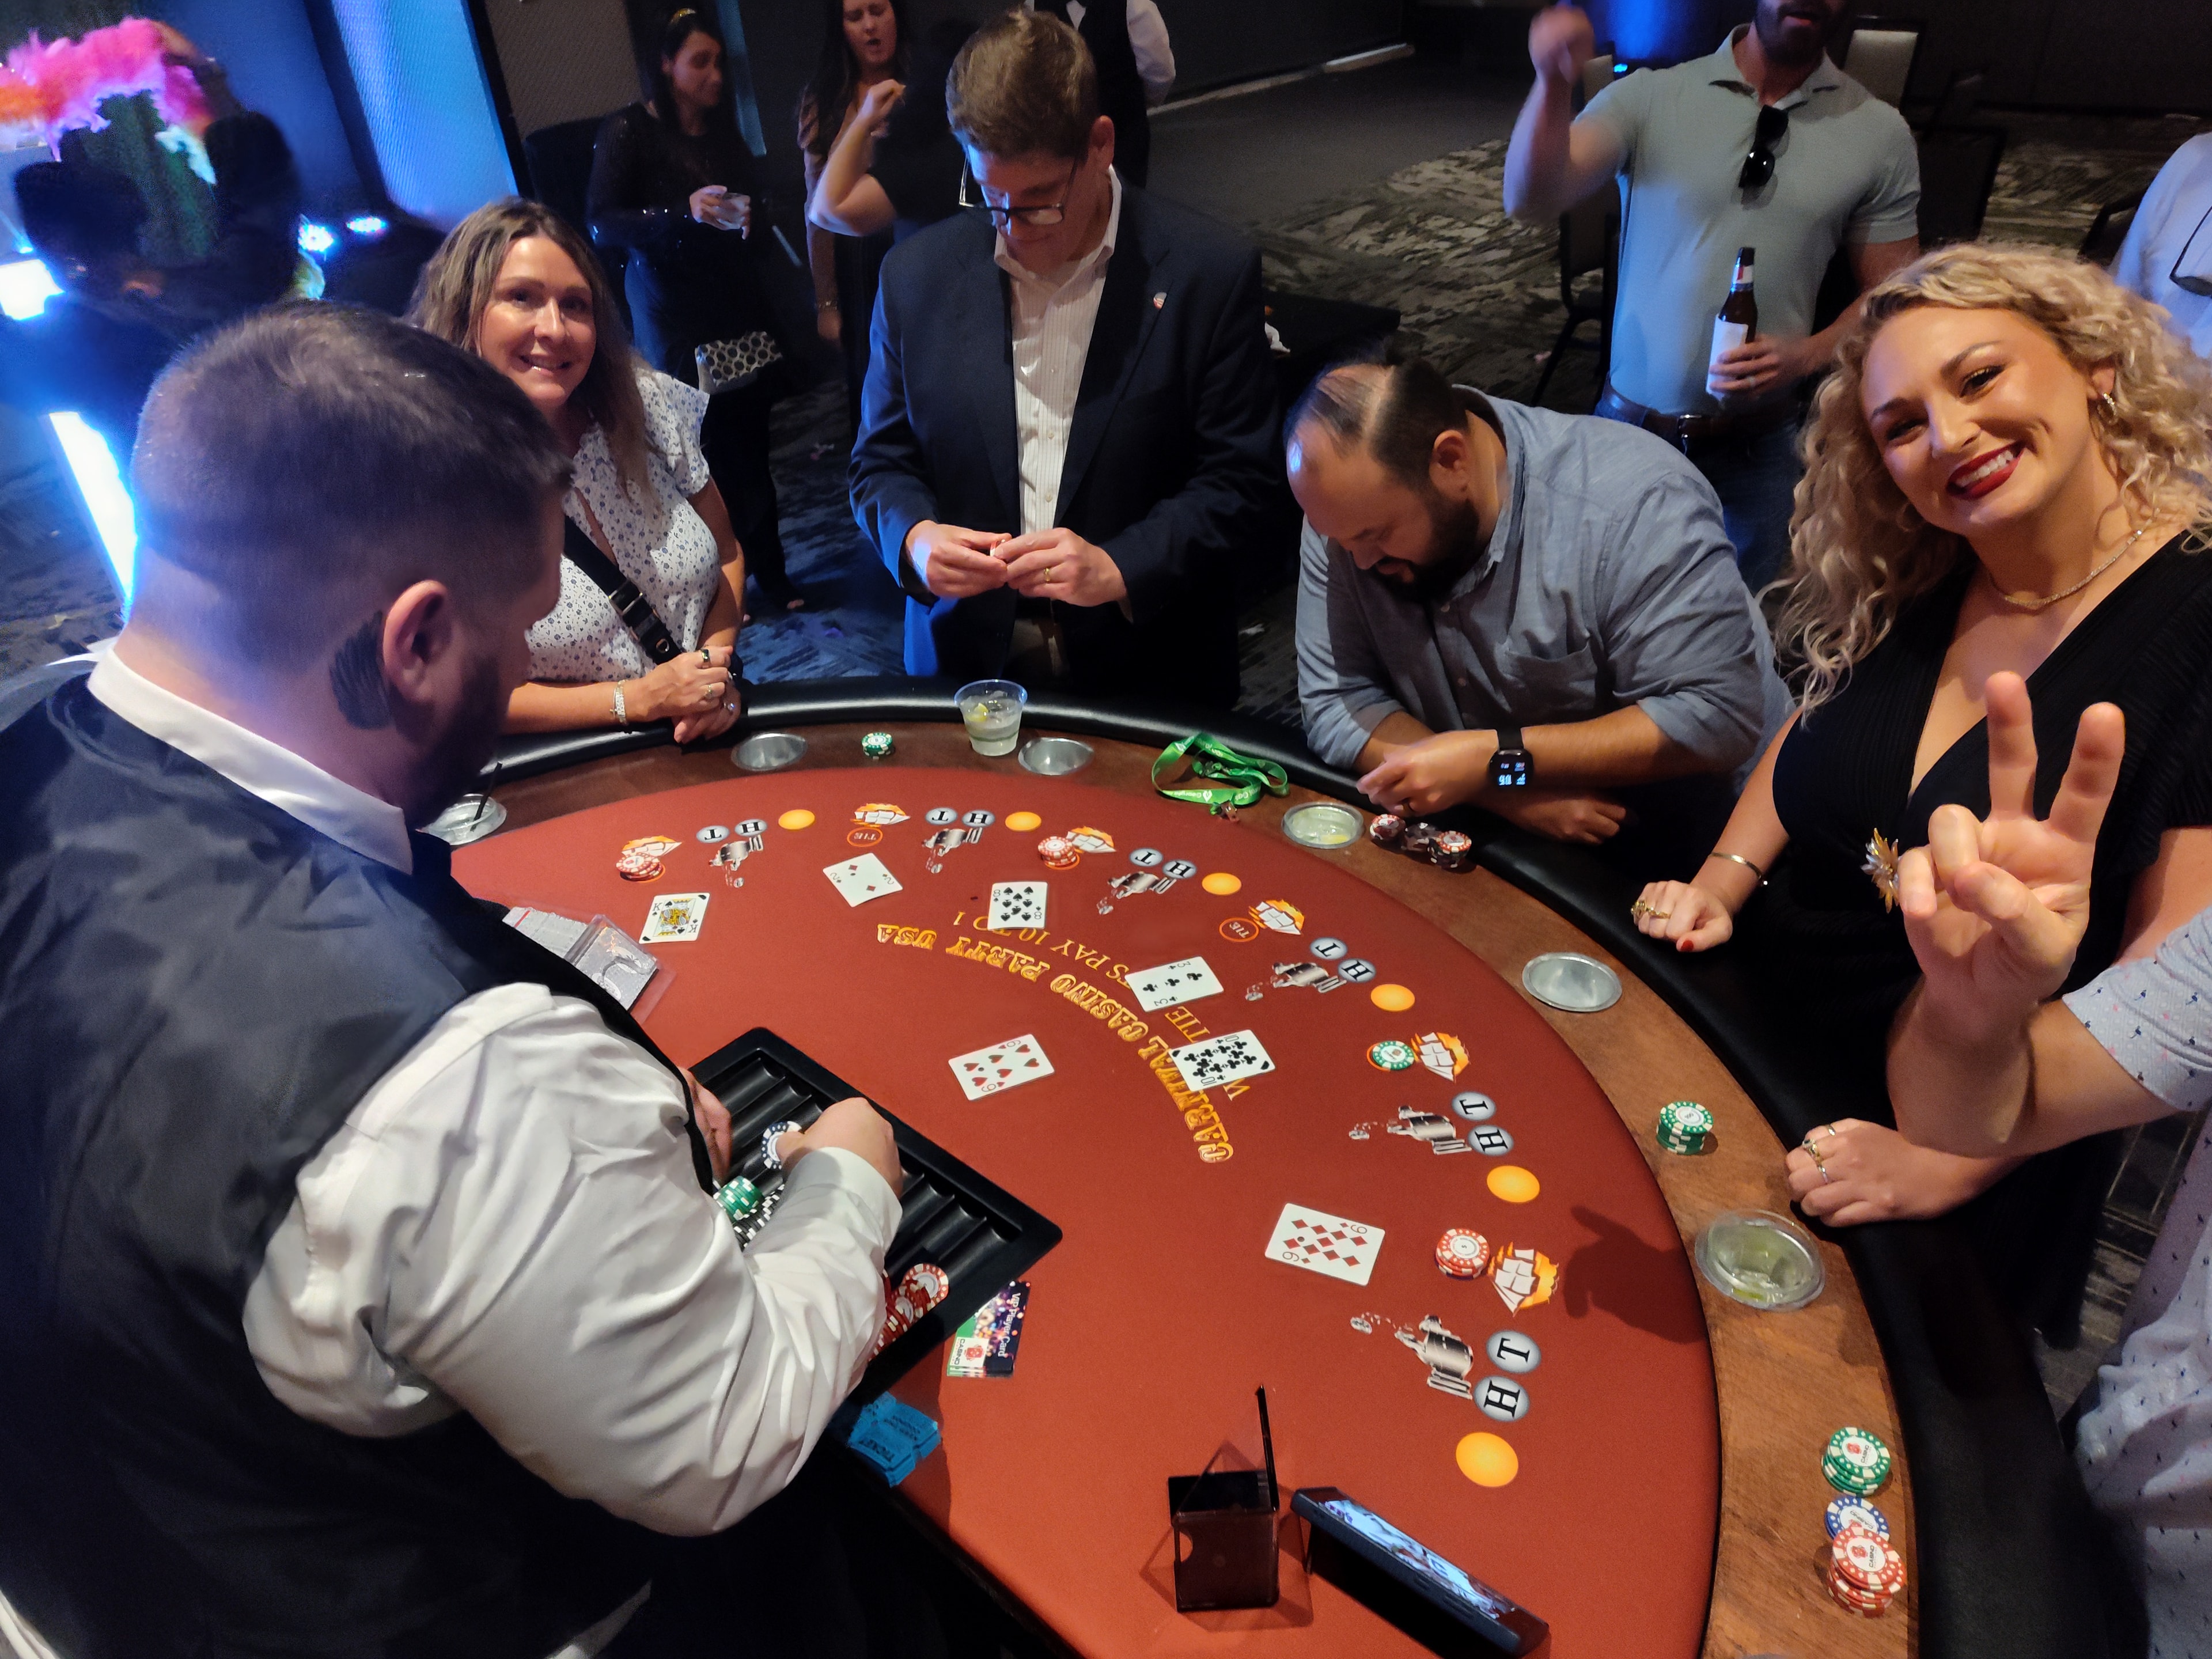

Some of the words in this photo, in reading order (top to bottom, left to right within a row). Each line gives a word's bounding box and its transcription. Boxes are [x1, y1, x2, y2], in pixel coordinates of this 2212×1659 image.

[931, 811, 949, 821] T
[968, 813, 989, 824] H
[704, 829, 722, 840] T
[741, 821, 761, 834] H
[854, 832, 876, 841] TIE
[1135, 851, 1156, 864] T
[1167, 861, 1192, 877] H
[652, 903, 662, 911] K
[1034, 911, 1042, 919] 8
[688, 925, 698, 933] K
[877, 923, 937, 950] USA
[1049, 939, 1111, 971] PAY
[1315, 941, 1341, 957] T
[945, 936, 1051, 982] PARTY
[1342, 960, 1373, 981] H
[1050, 974, 1149, 1041] CASINO
[1154, 998, 1168, 1006] 3
[1164, 1006, 1210, 1043] TIE
[1224, 1034, 1239, 1043] 10
[1200, 1076, 1217, 1086] 10
[1138, 1035, 1234, 1164] CARNIVAL
[1459, 1099, 1488, 1115] T
[1474, 1128, 1508, 1153] H
[1003, 1308, 1017, 1335] Player
[954, 1339, 965, 1365] CASINO
[998, 1336, 1010, 1357] Card
[1497, 1337, 1531, 1363] T
[1483, 1380, 1520, 1418] H
[1861, 1445, 1869, 1464] CASINO
[1850, 1510, 1873, 1529] CASINO
